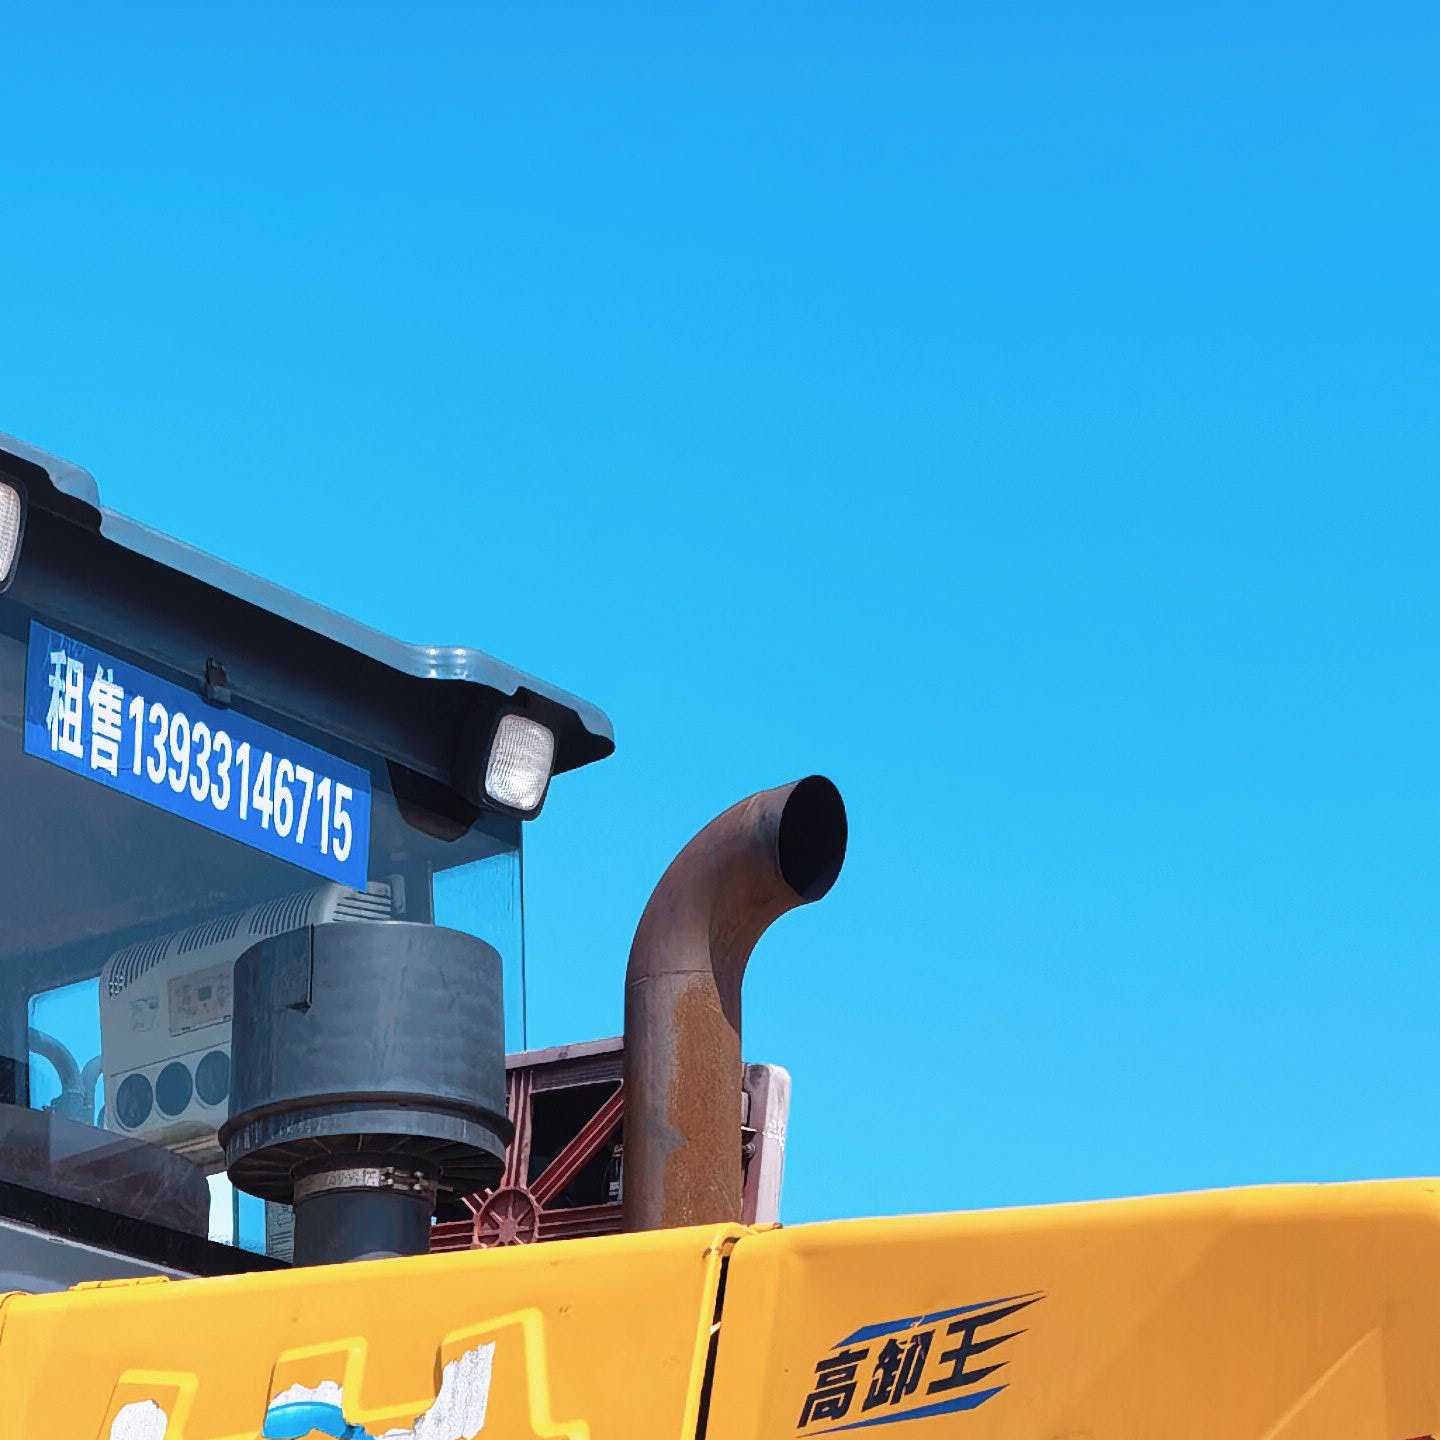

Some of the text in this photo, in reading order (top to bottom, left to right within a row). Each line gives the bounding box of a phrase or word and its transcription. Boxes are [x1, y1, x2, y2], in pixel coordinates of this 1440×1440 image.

[46, 649, 353, 862] 租售13933146715
[796, 1295, 1047, 1429] 高卸王
